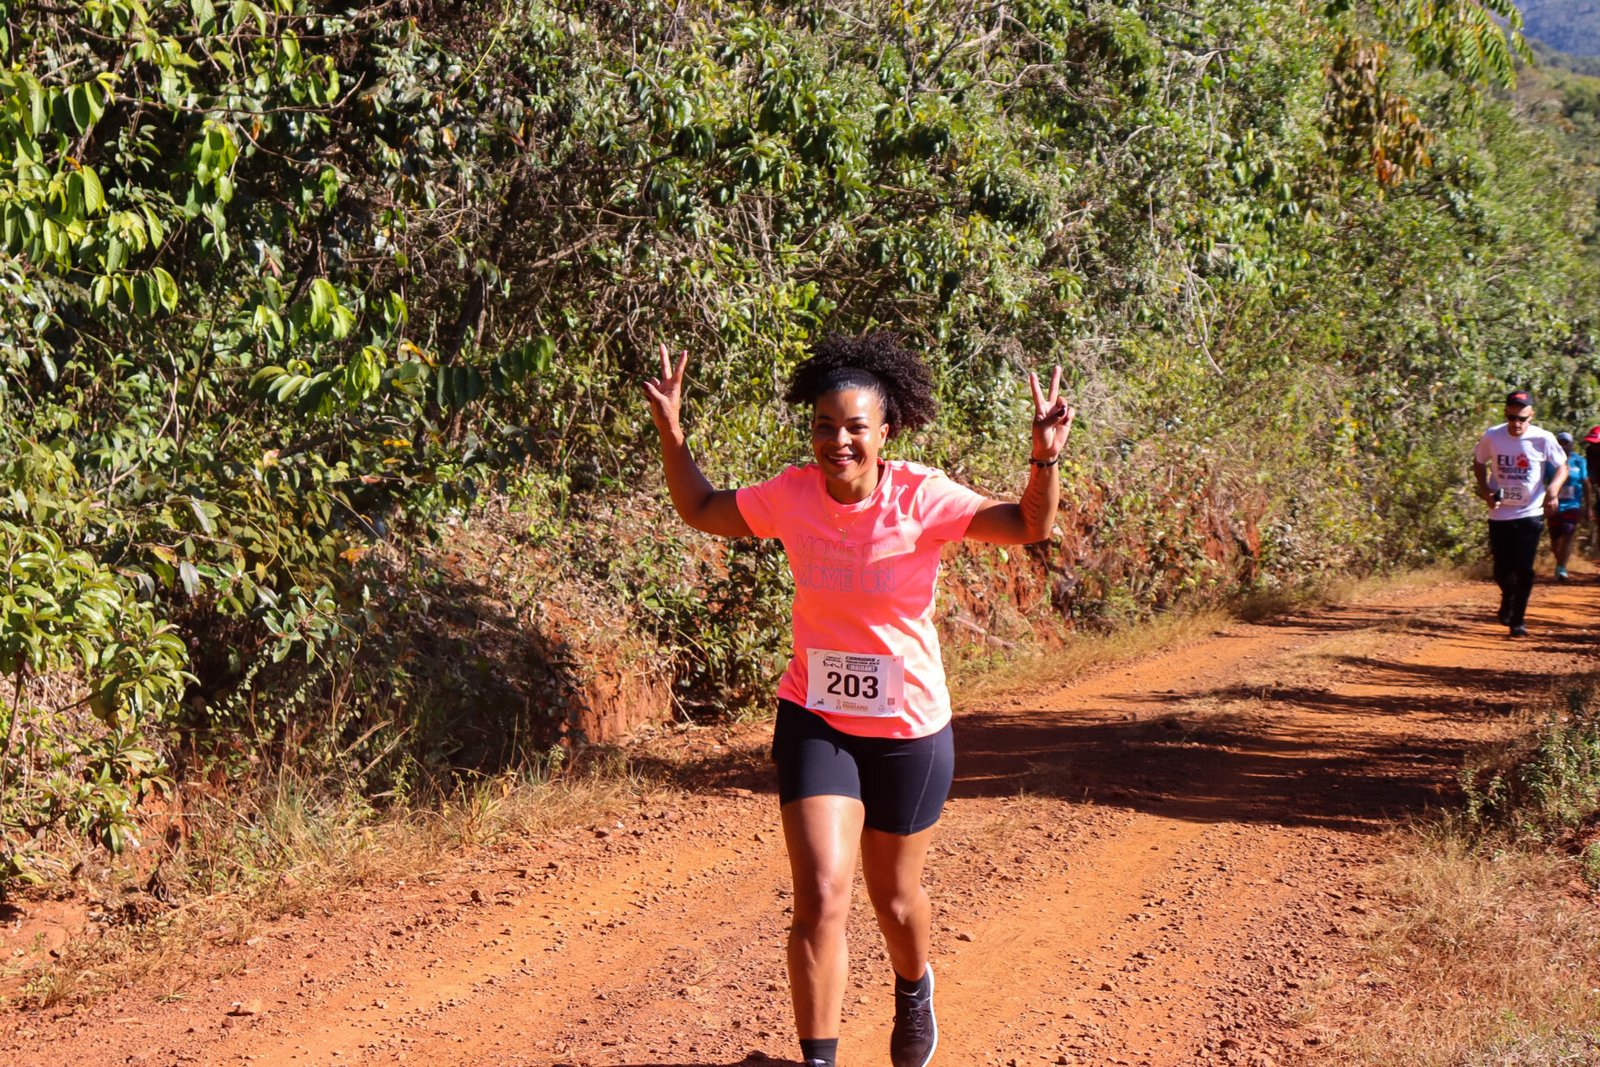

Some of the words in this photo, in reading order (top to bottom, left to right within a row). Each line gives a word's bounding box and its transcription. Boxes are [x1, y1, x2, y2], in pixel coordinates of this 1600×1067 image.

[1497, 454, 1515, 466] EU
[860, 569, 895, 592] ON
[827, 671, 879, 699] 203
